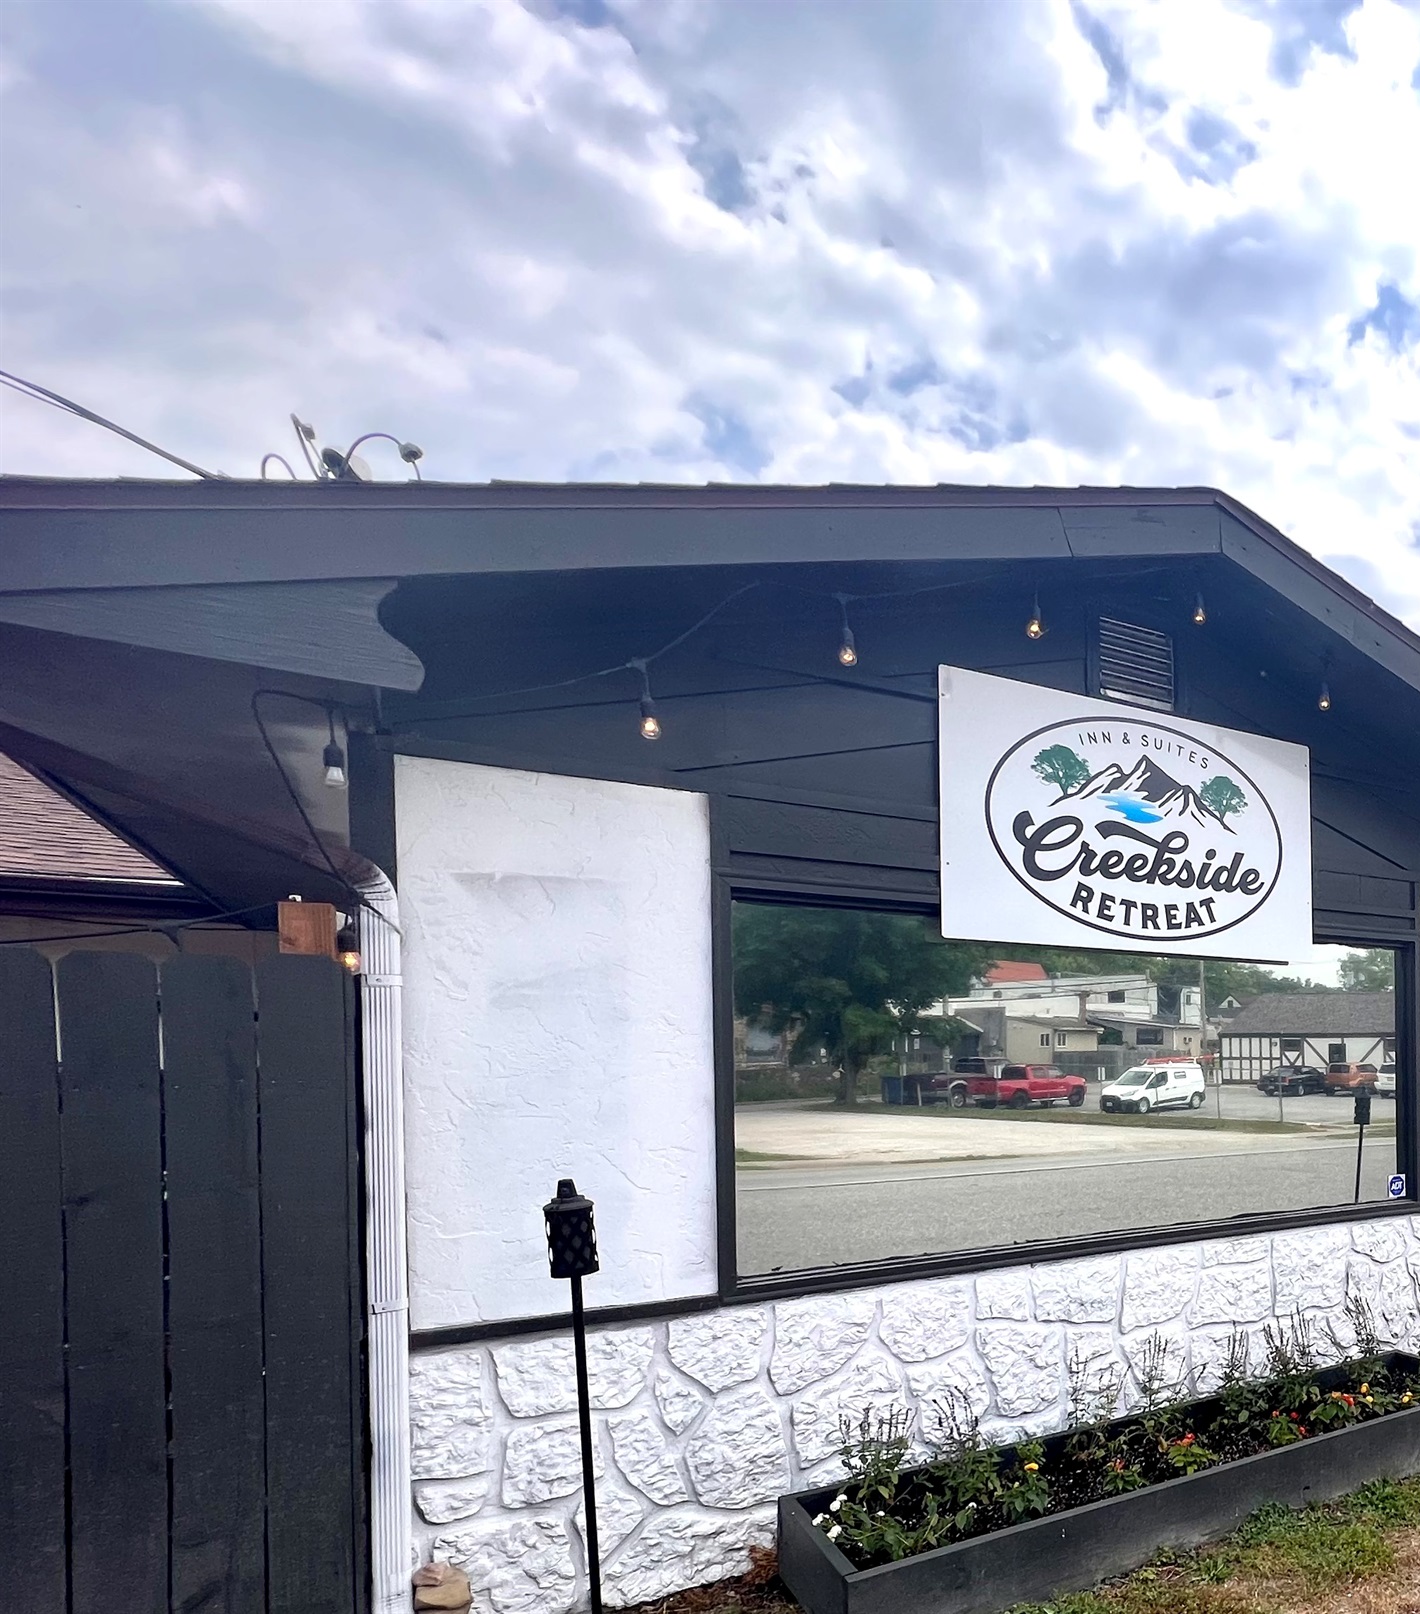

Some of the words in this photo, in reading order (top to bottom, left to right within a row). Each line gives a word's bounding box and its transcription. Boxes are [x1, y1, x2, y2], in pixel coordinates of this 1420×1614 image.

[1079, 731, 1112, 747] INN
[1121, 731, 1131, 745] &
[1140, 734, 1209, 770] SUITES
[1012, 810, 1265, 896] Creekside
[1069, 881, 1217, 930] RETREAT
[1390, 1181, 1404, 1191] ADT
